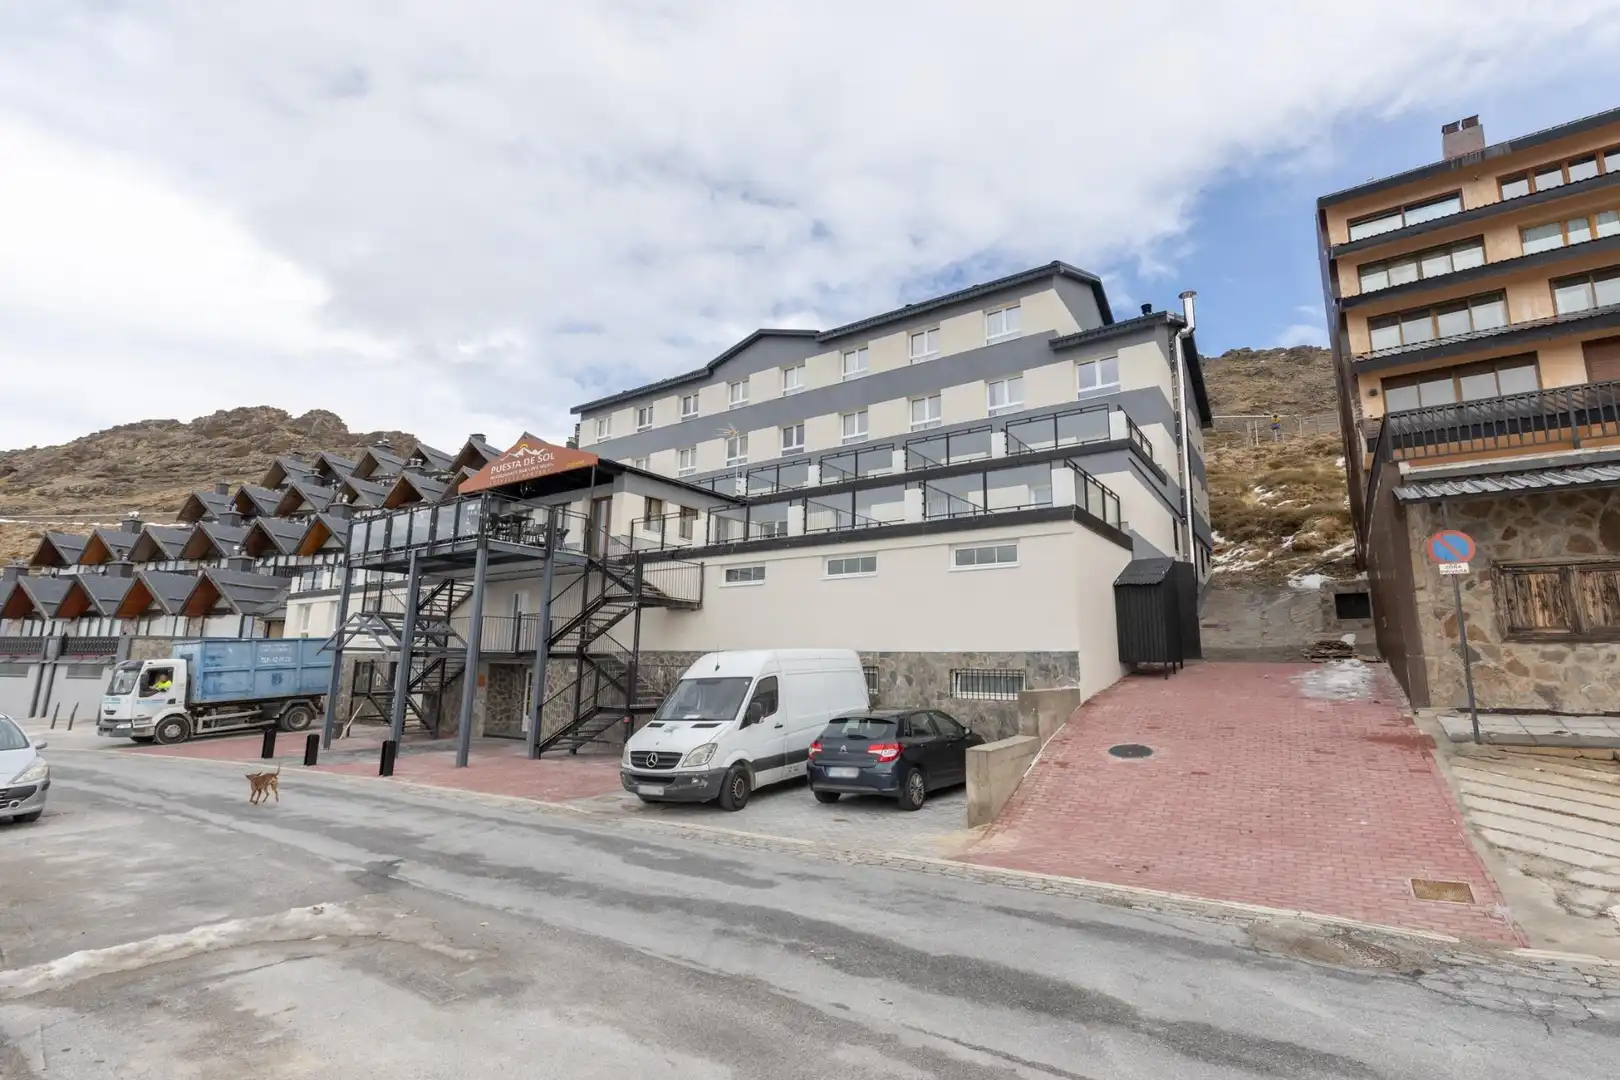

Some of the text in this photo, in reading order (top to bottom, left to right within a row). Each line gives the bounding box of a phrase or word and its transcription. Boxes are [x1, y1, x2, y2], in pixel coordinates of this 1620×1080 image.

[491, 460, 521, 474] PUESTA
[523, 456, 535, 466] DE
[537, 452, 555, 462] SOL
